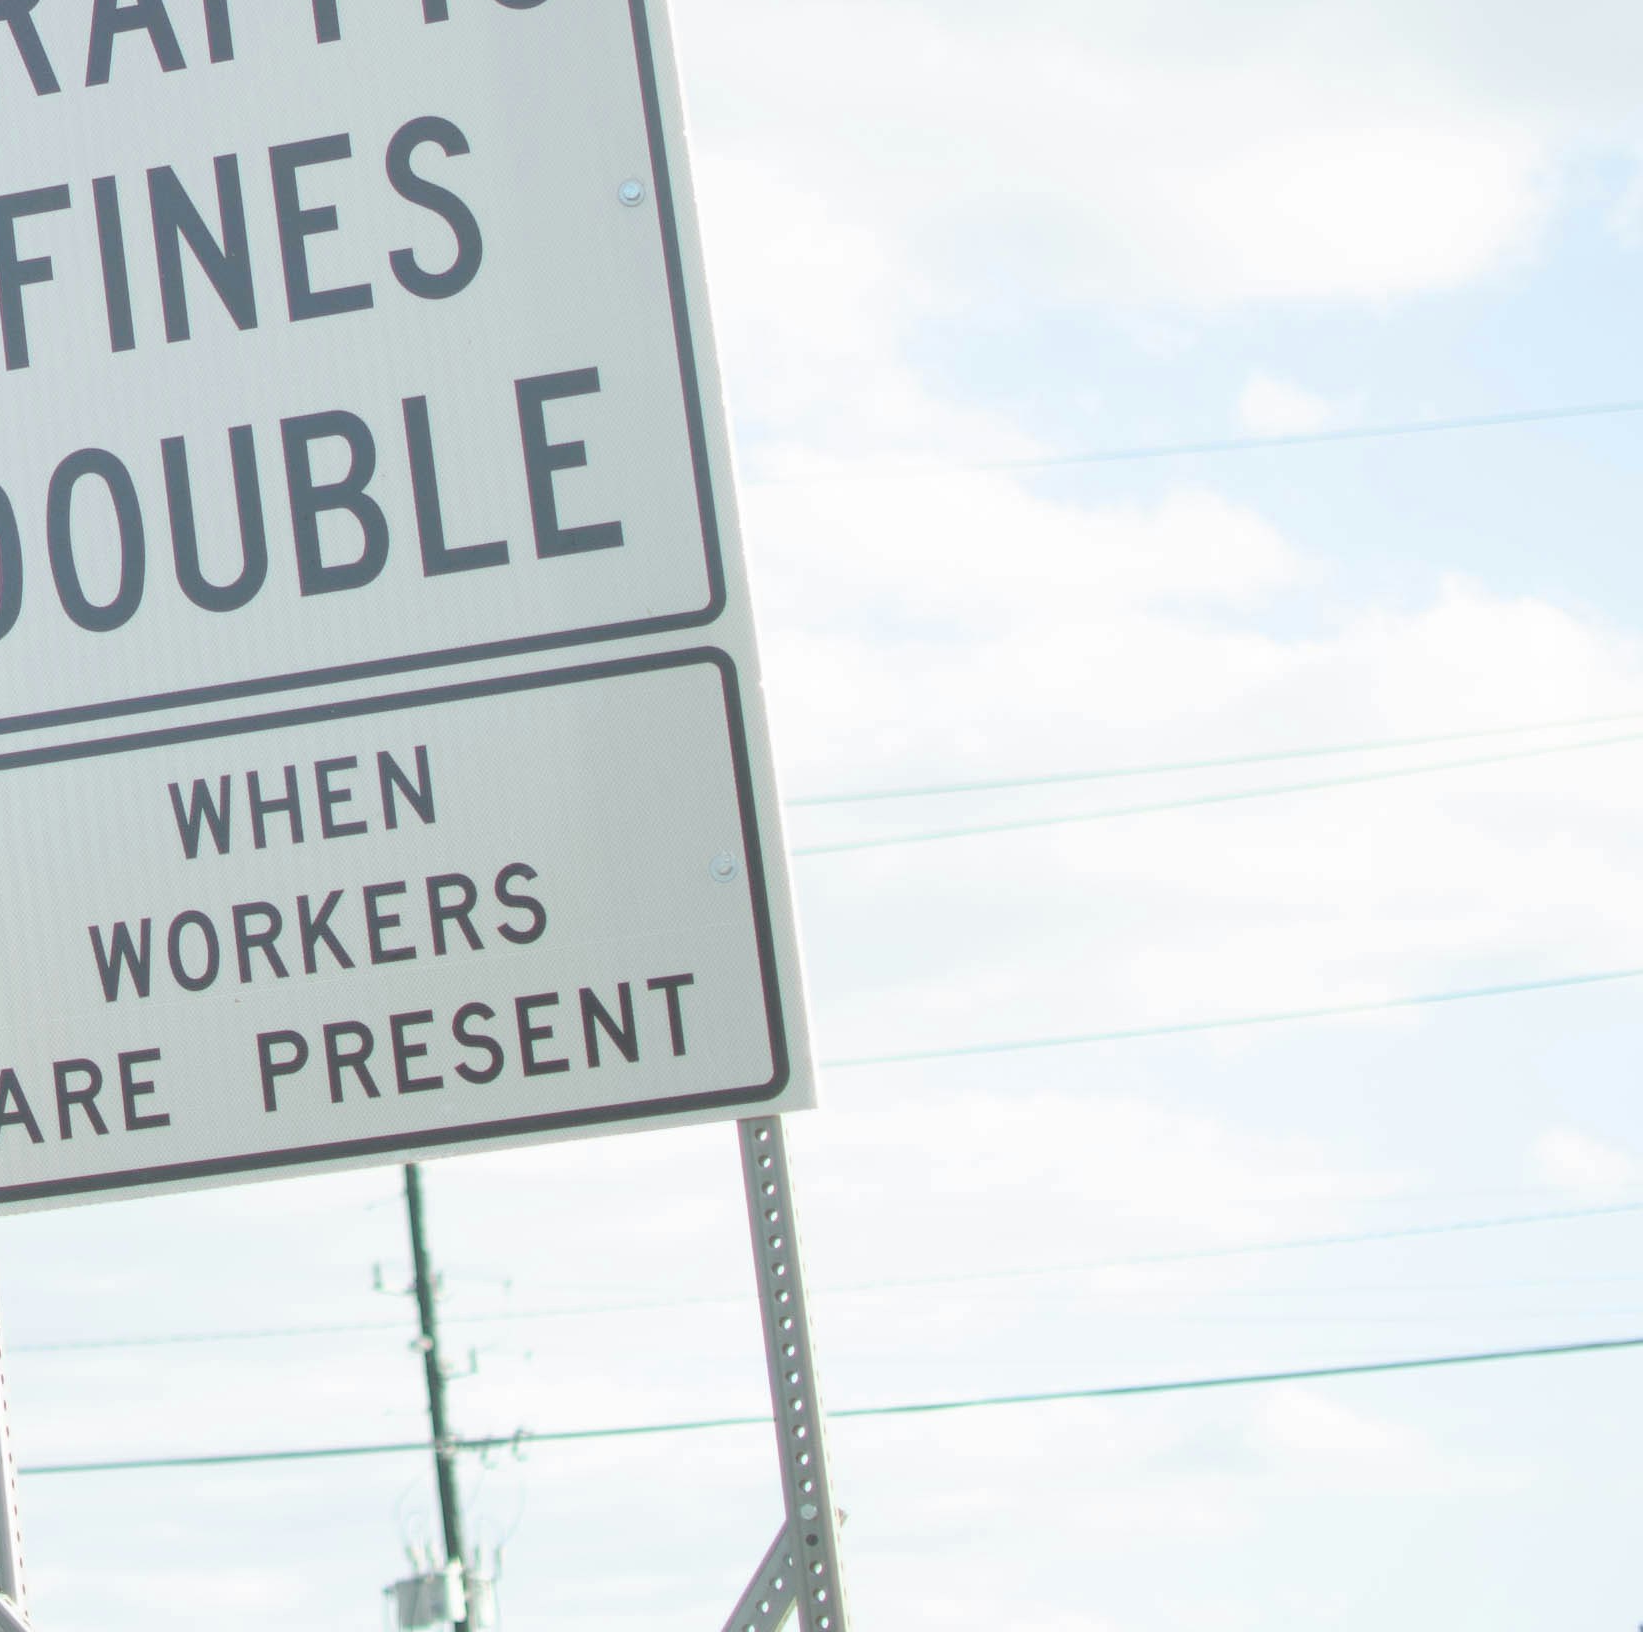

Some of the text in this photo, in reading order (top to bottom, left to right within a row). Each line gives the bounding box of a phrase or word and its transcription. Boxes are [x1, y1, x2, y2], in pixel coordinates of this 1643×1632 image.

[167, 744, 437, 862] WHEN
[87, 862, 550, 1005] WORKERS
[256, 972, 696, 1115] PRESENT
